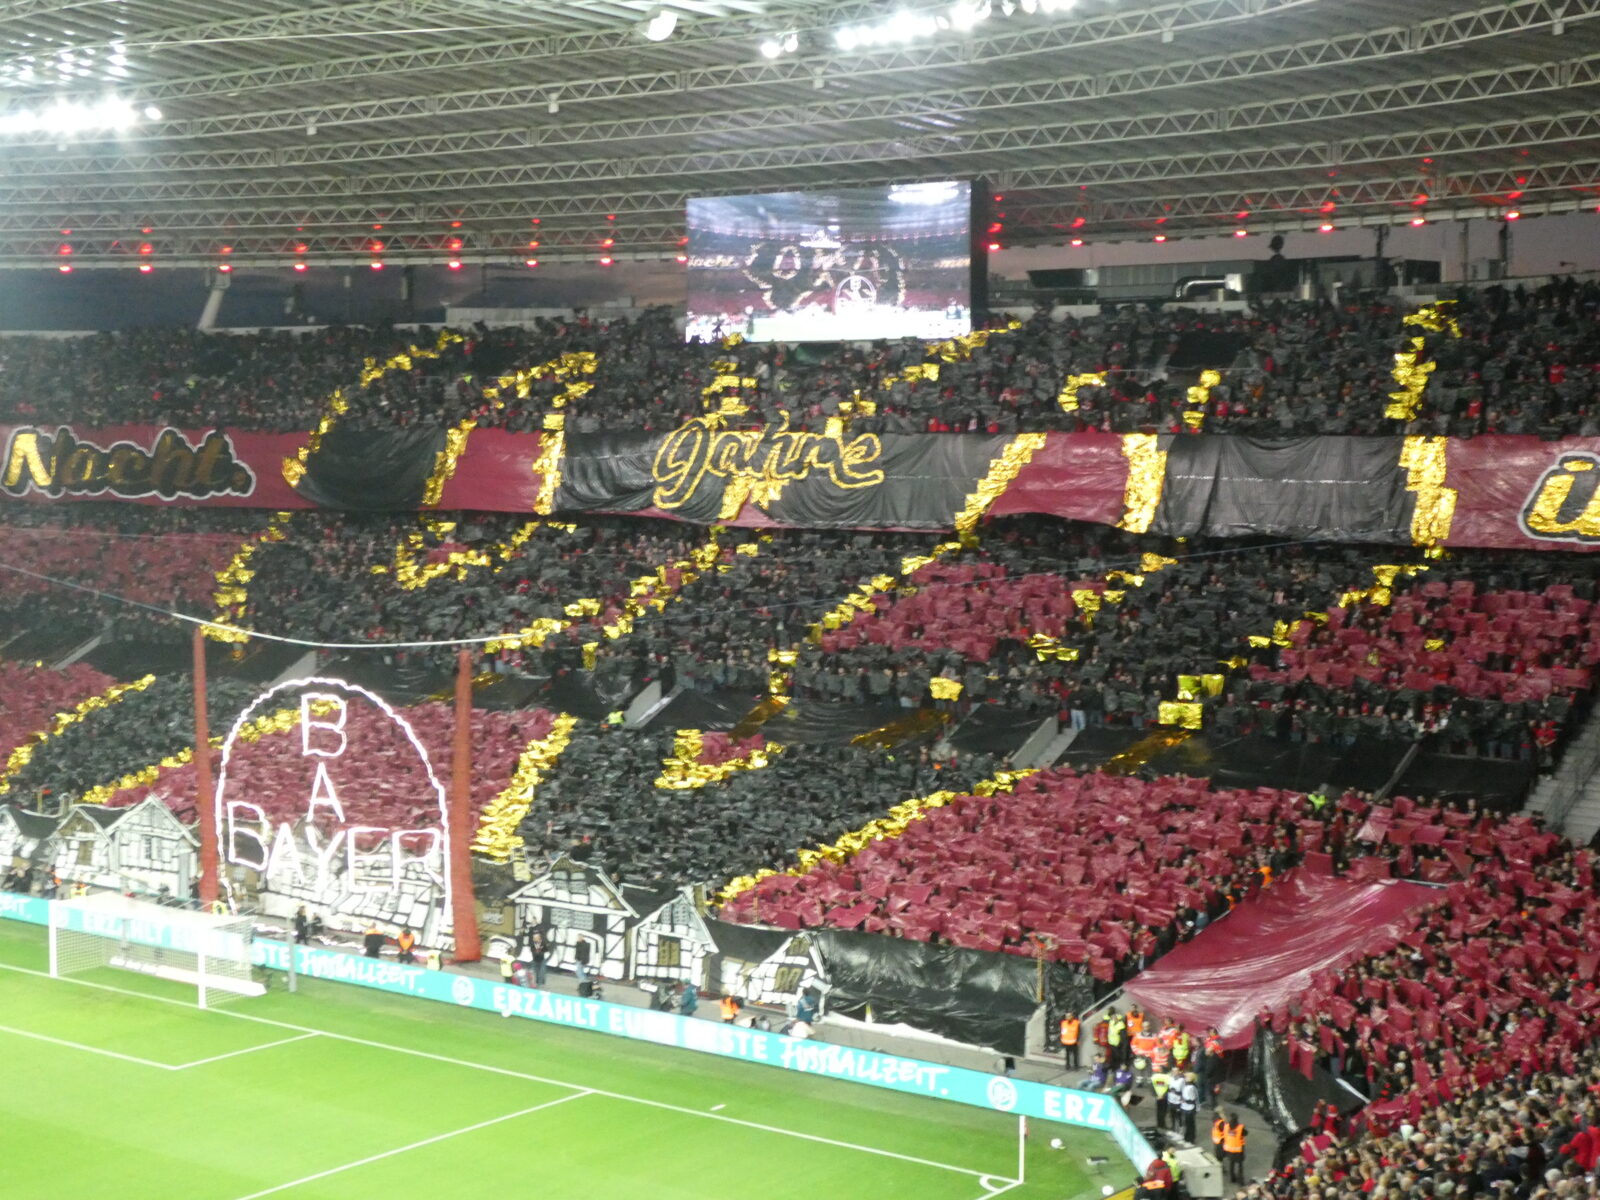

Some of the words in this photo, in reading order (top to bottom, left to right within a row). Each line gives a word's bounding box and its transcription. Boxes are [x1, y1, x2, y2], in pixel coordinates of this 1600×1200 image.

[3, 429, 252, 490] Nacht.
[227, 800, 445, 894] BAYER
[493, 986, 599, 1028] ERZÄHLT
